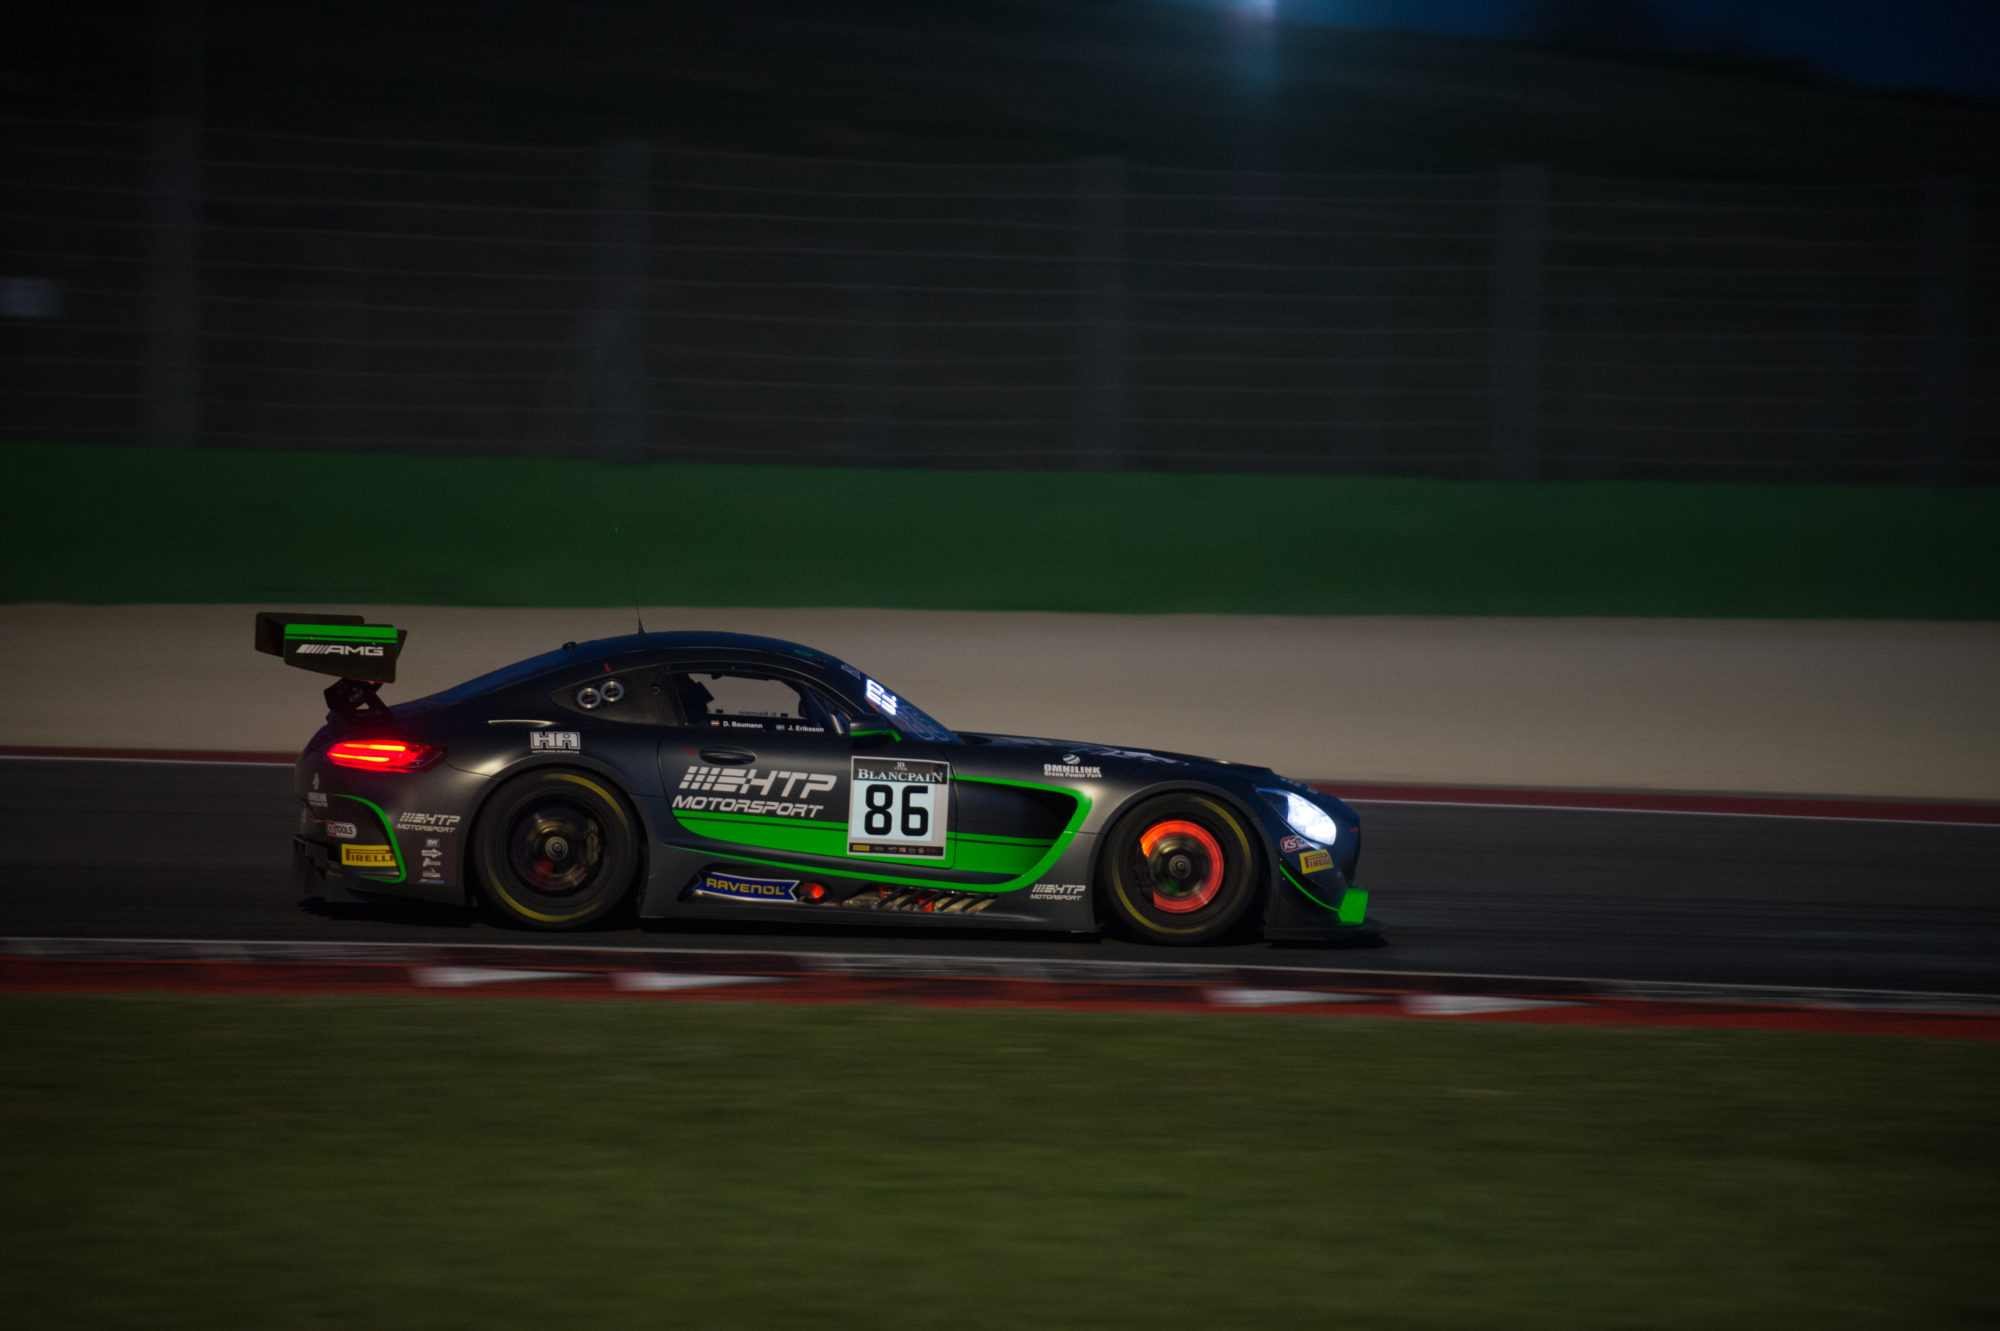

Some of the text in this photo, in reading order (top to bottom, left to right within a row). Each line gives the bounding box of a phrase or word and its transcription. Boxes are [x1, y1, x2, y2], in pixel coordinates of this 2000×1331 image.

[323, 645, 384, 657] AMG
[857, 768, 944, 783] BLANCPAIN
[671, 794, 824, 818] MOTORSPORT
[864, 784, 929, 837] 86
[396, 823, 457, 833] MOTORSPORT
[706, 877, 785, 896] RAVENOL
[1029, 893, 1082, 901] MOTORSPORT
